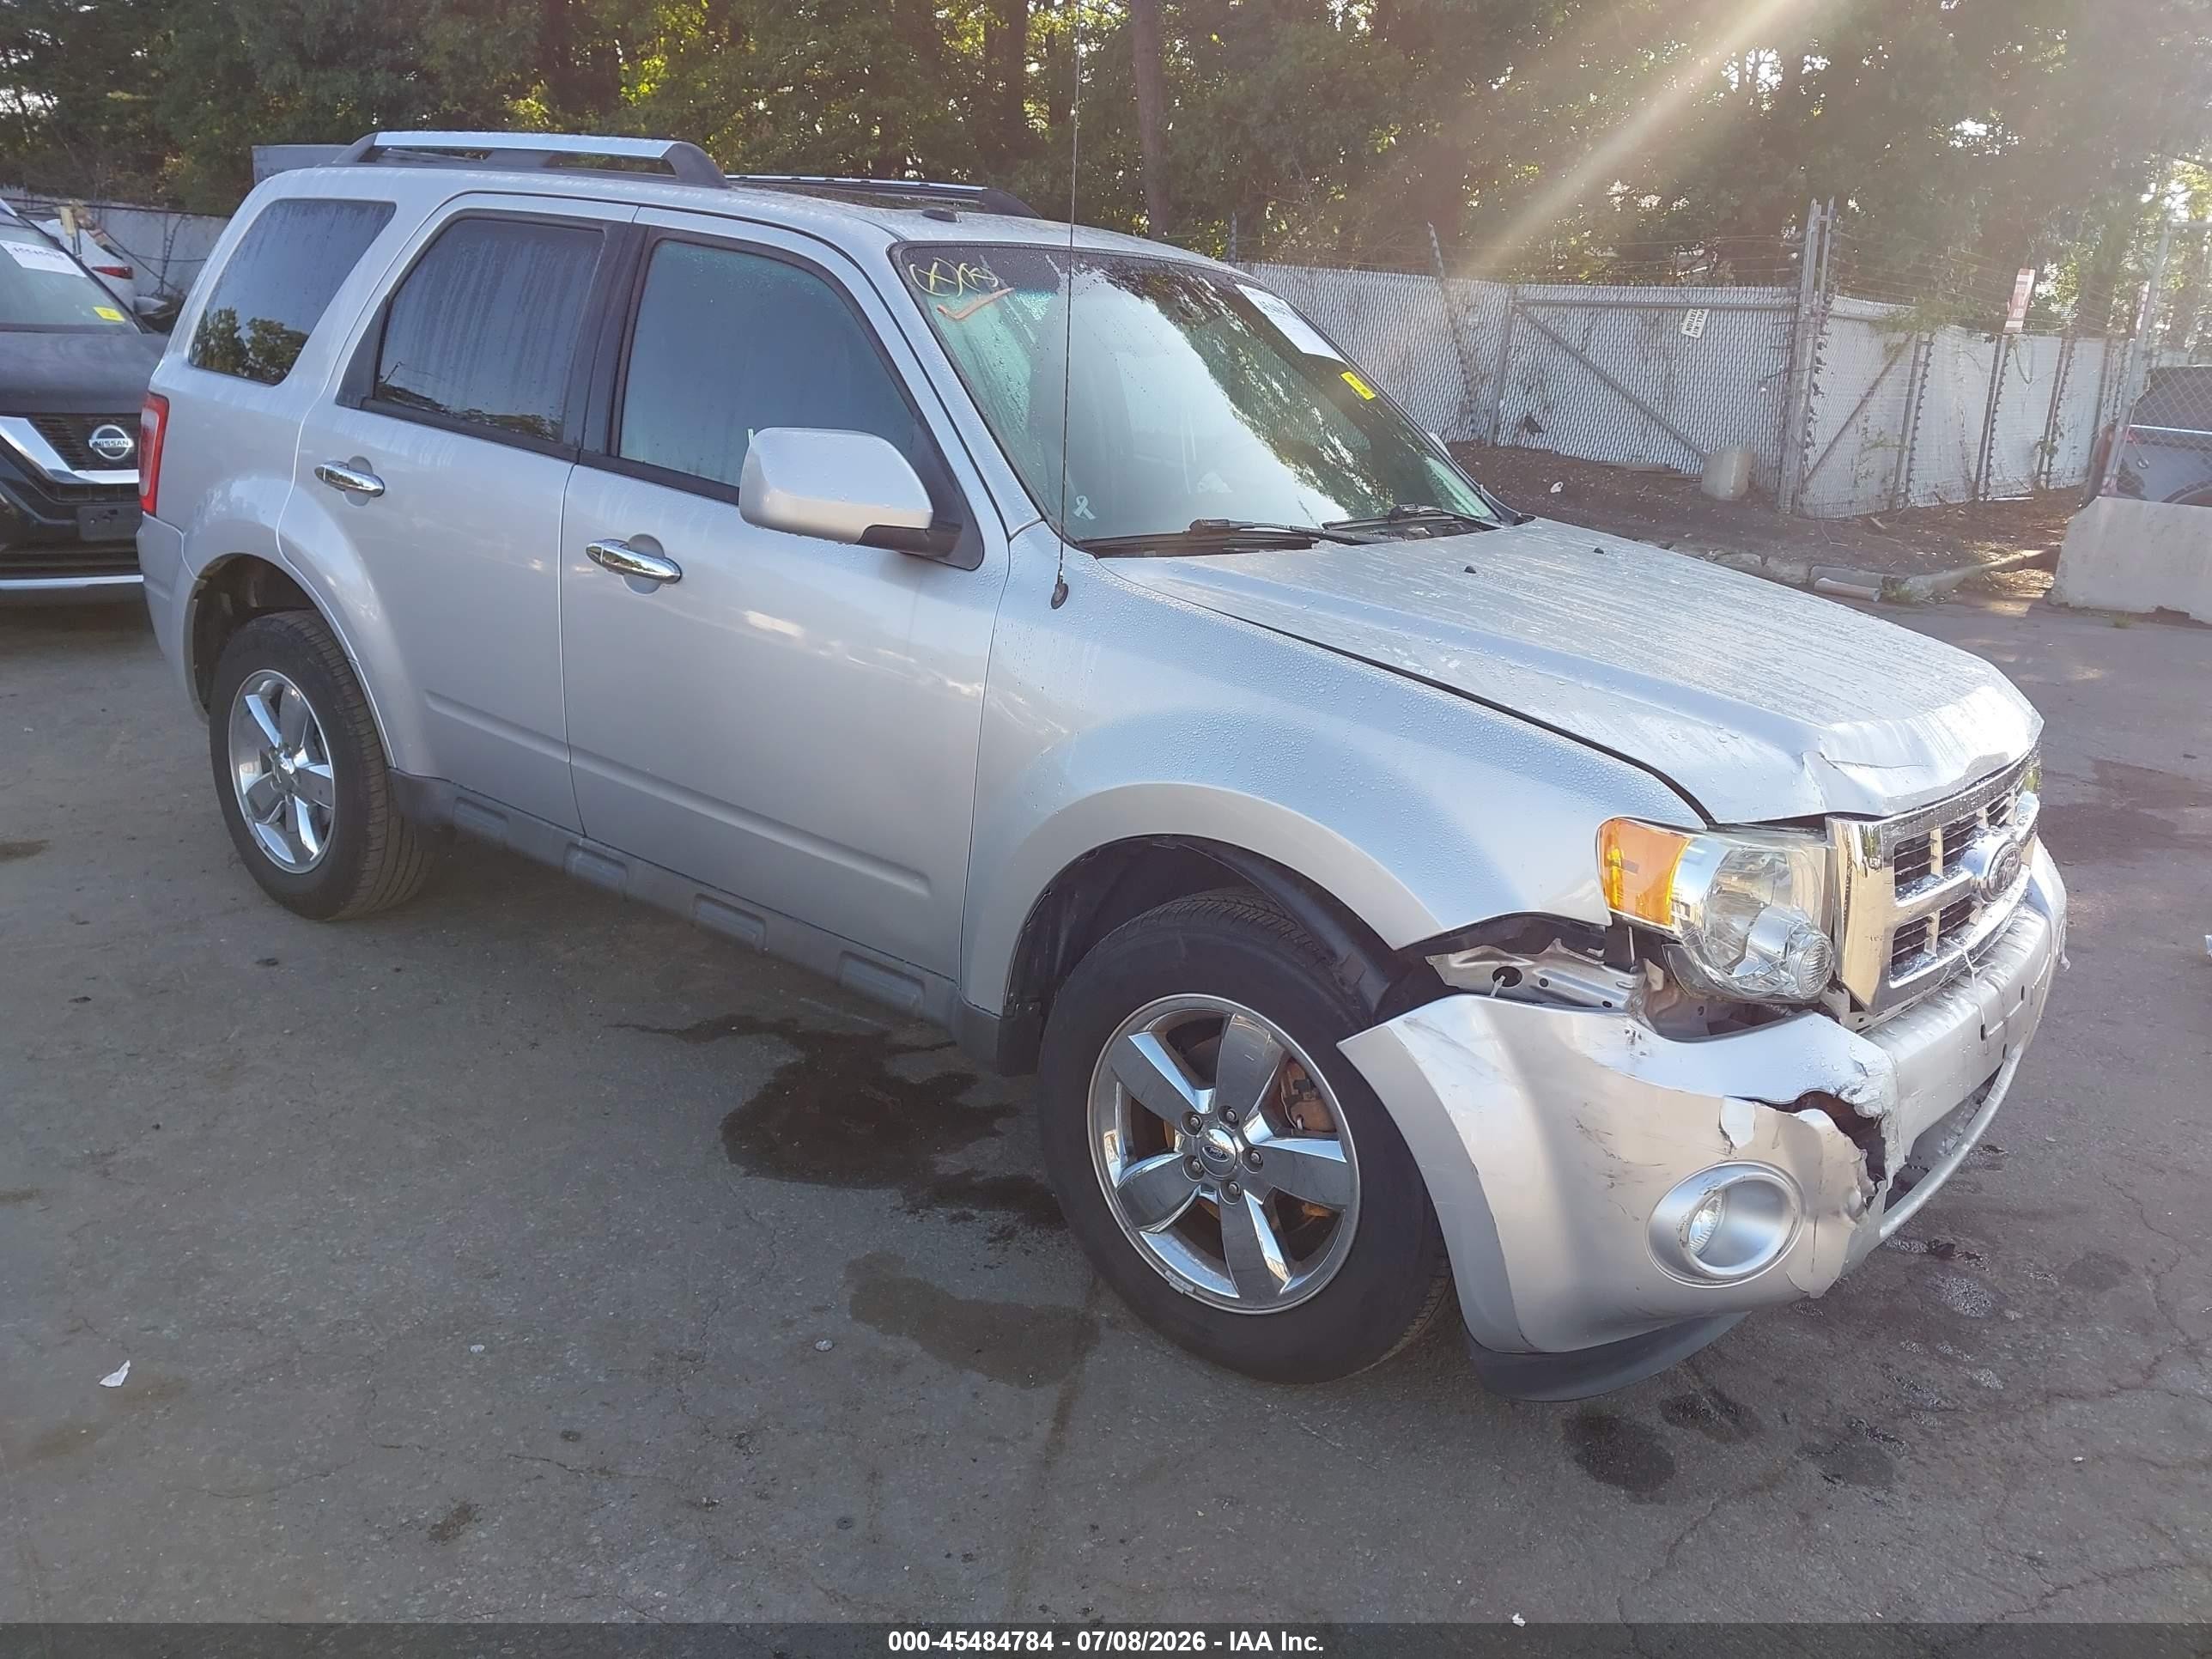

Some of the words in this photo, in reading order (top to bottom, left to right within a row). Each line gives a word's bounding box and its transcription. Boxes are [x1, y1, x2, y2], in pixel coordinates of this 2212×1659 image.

[1685, 309, 1698, 331] TATION
[1692, 309, 1705, 336] PILL-KIT
[90, 439, 130, 447] NISSAN
